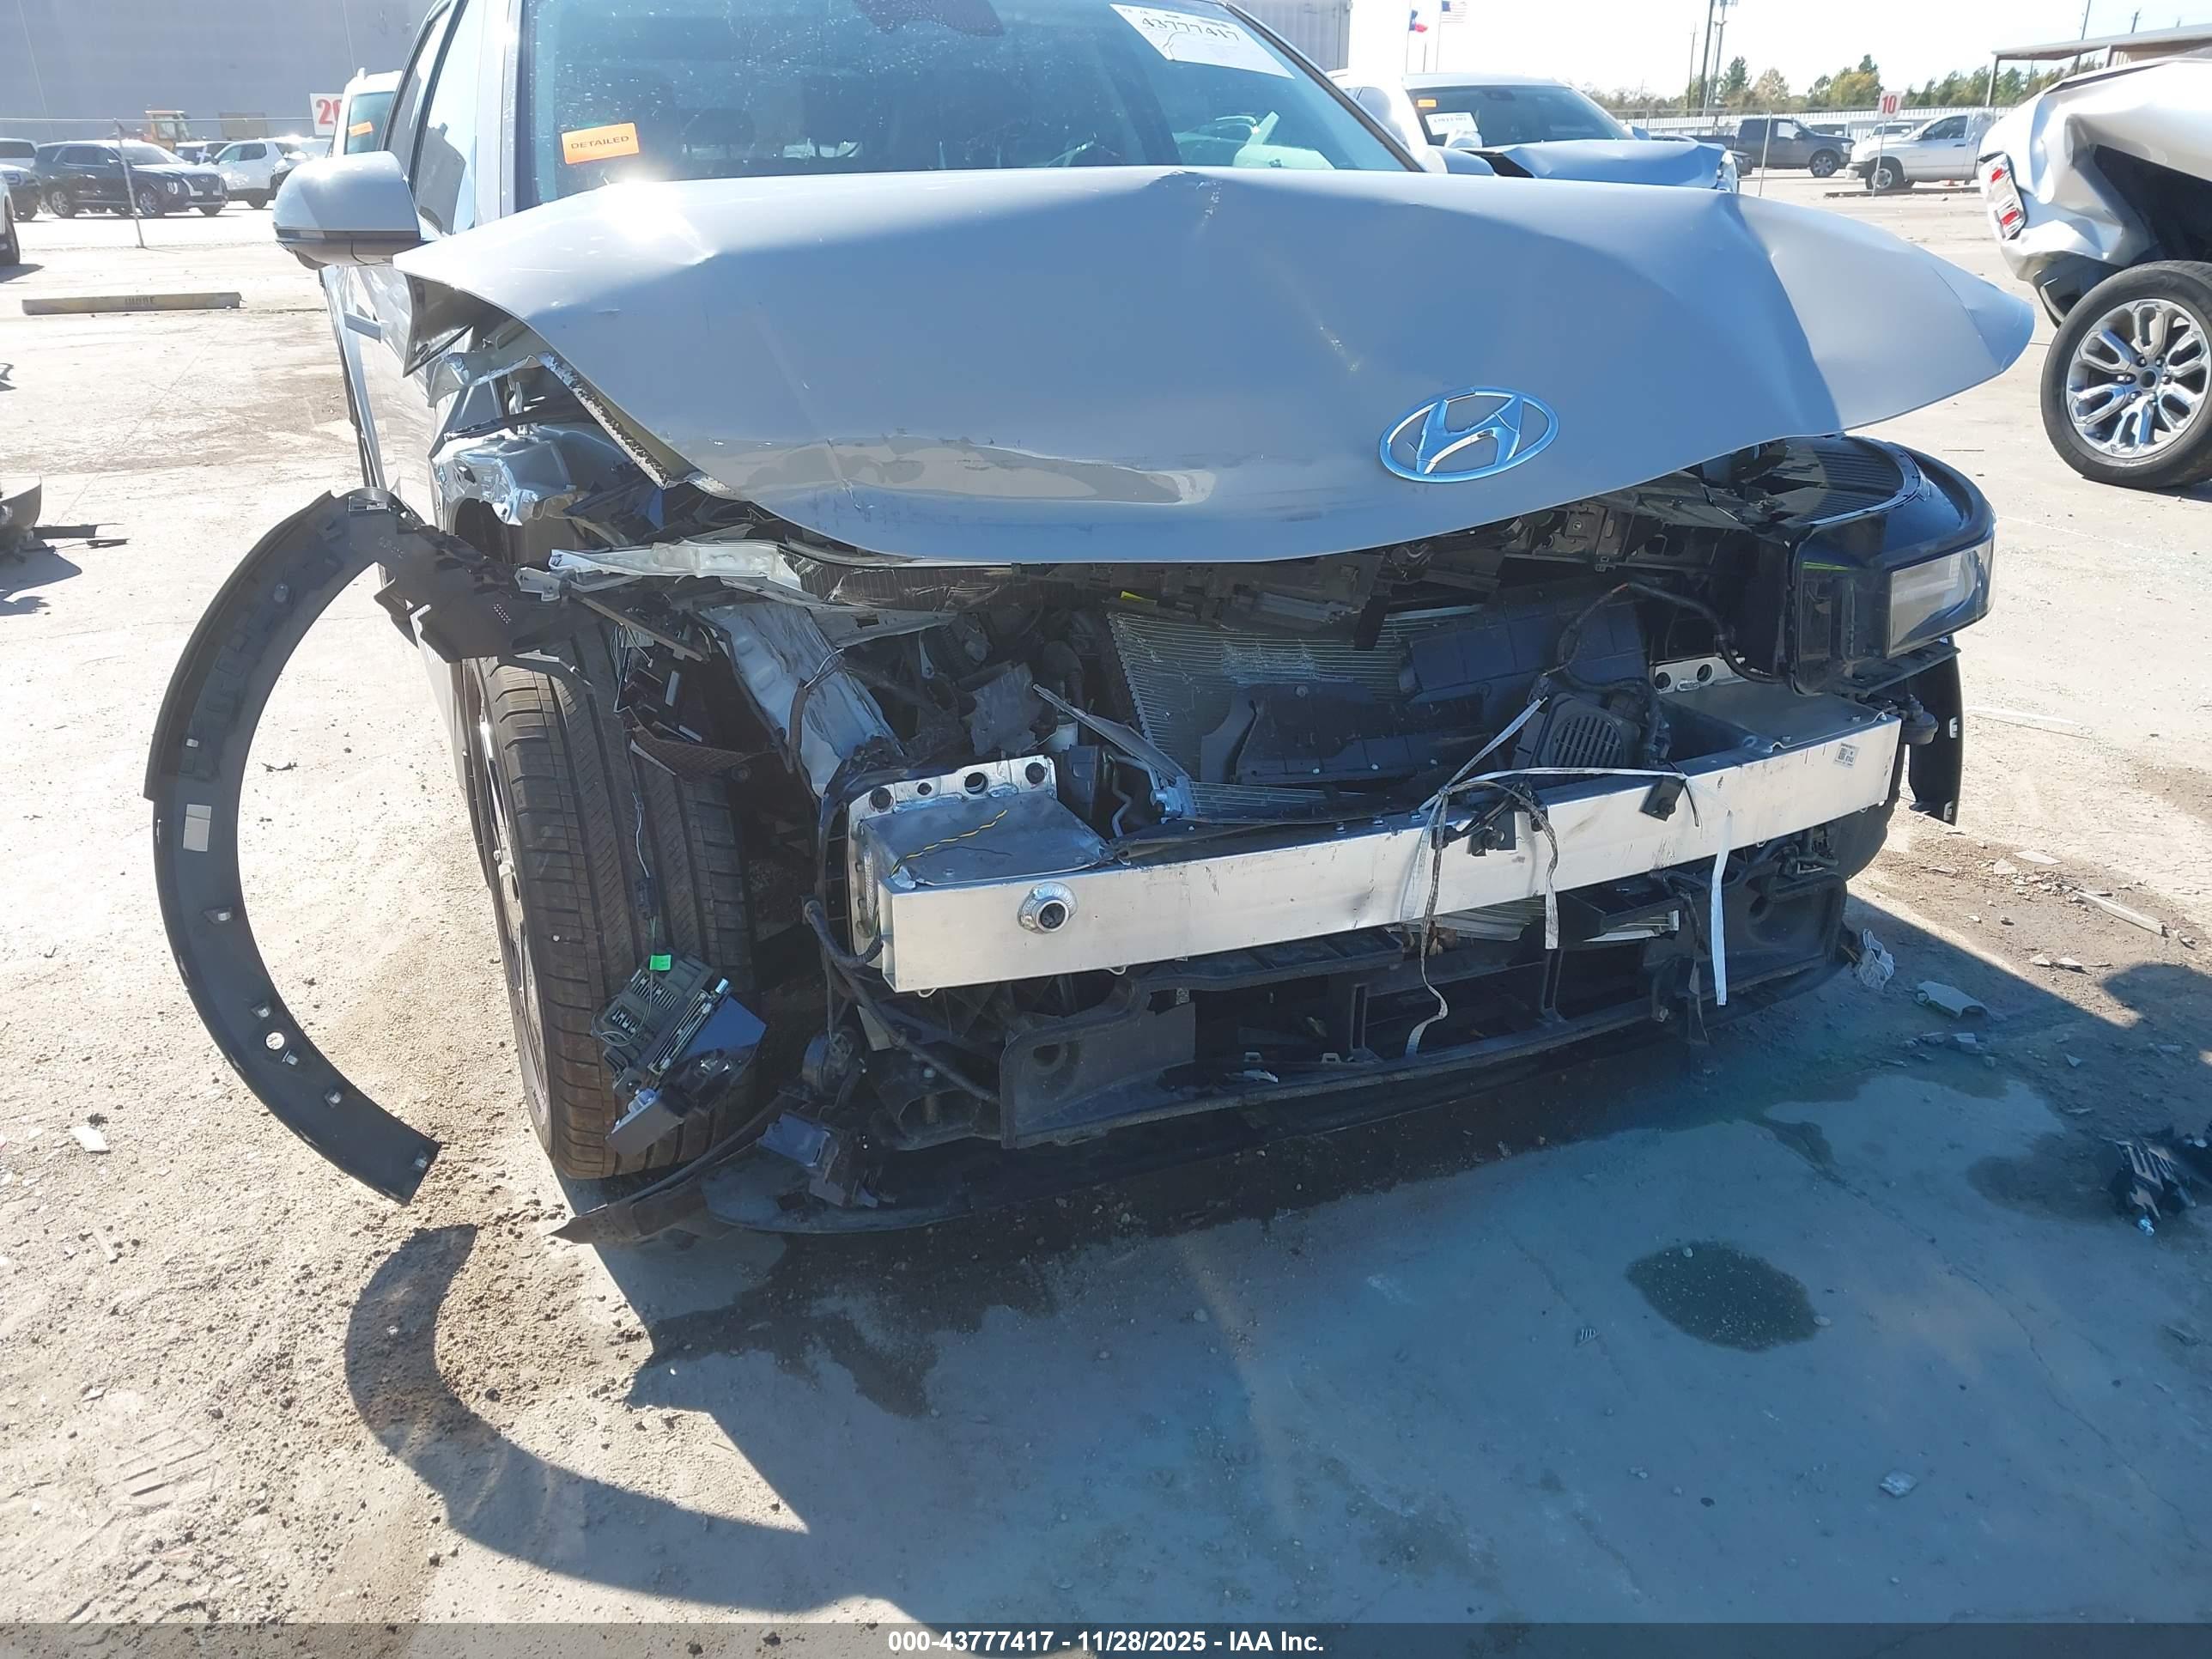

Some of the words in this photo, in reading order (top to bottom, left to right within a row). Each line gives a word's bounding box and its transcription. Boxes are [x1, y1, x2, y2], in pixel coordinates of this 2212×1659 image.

[1142, 17, 1240, 41] 43777417
[1881, 94, 1897, 114] 10
[570, 136, 629, 149] DETAILED
